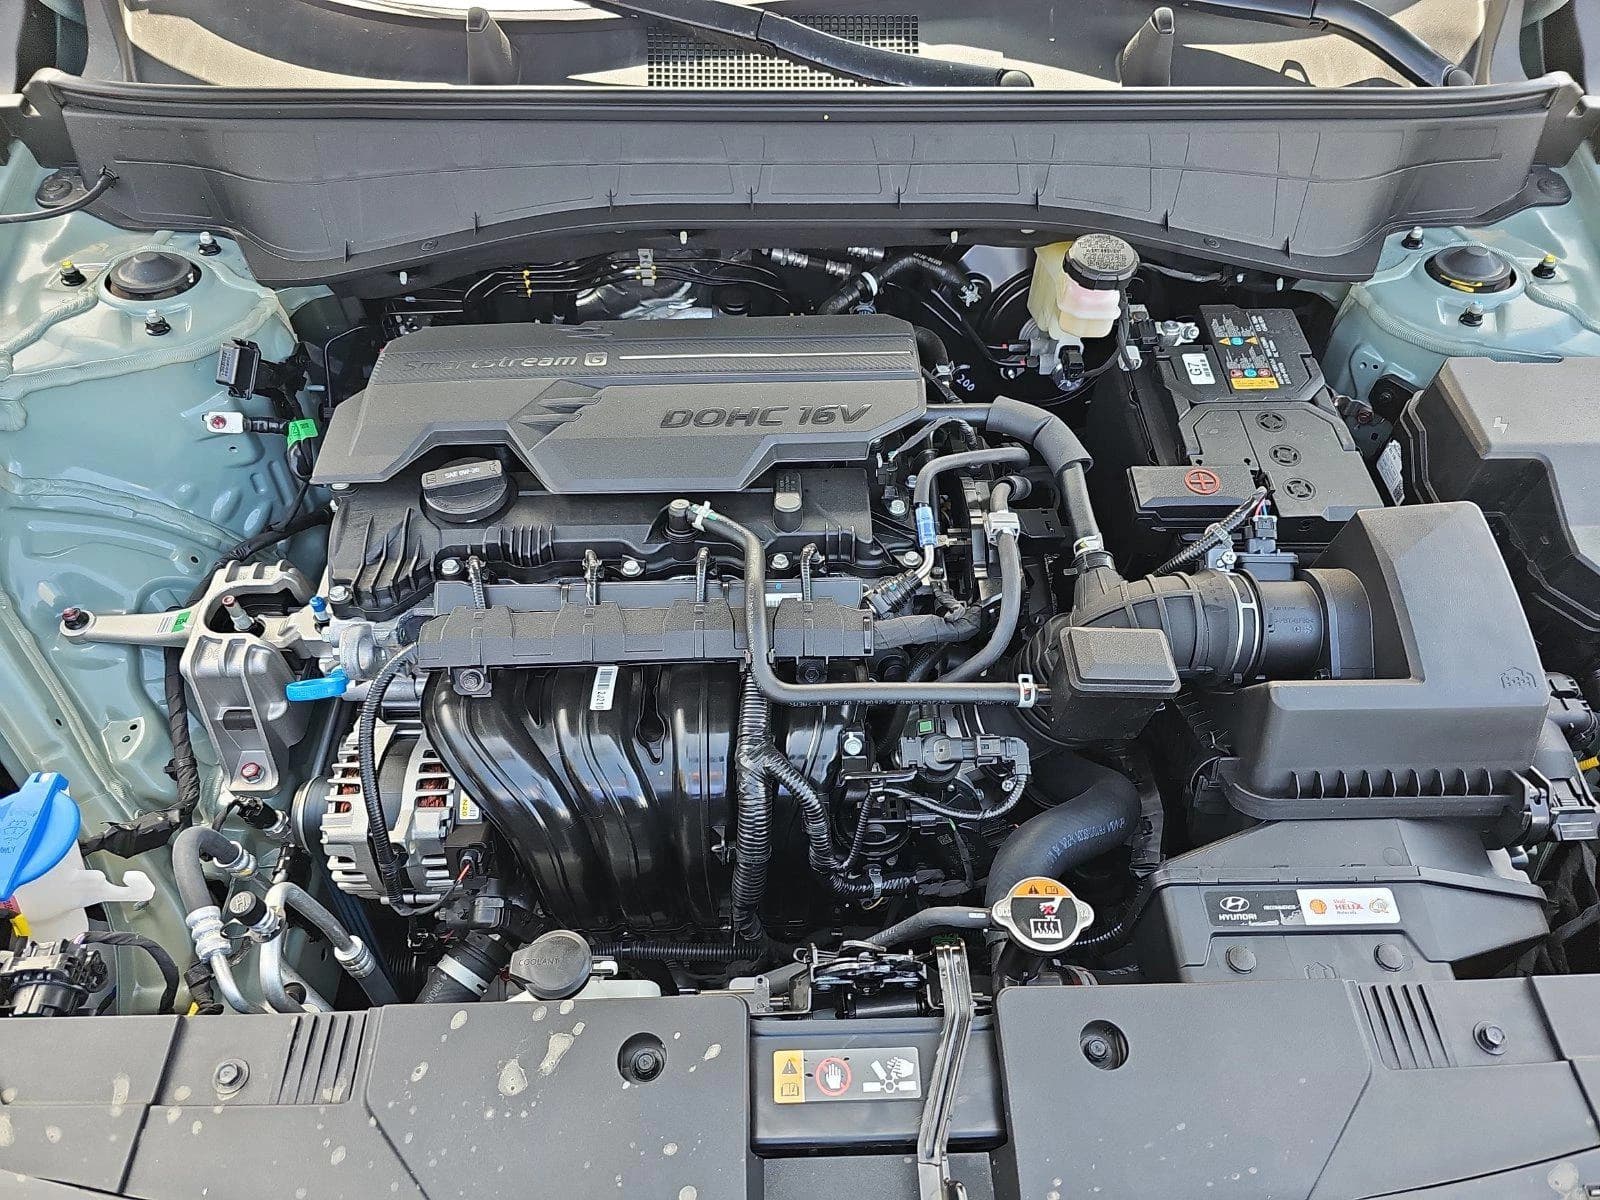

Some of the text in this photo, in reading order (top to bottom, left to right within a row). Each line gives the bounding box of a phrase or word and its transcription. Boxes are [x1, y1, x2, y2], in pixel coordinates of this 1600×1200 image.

[955, 373, 976, 392] 200
[660, 404, 873, 429] DOHC 16V
[1218, 913, 1258, 921] HYUNDAI
[518, 956, 560, 967] COOLANT
